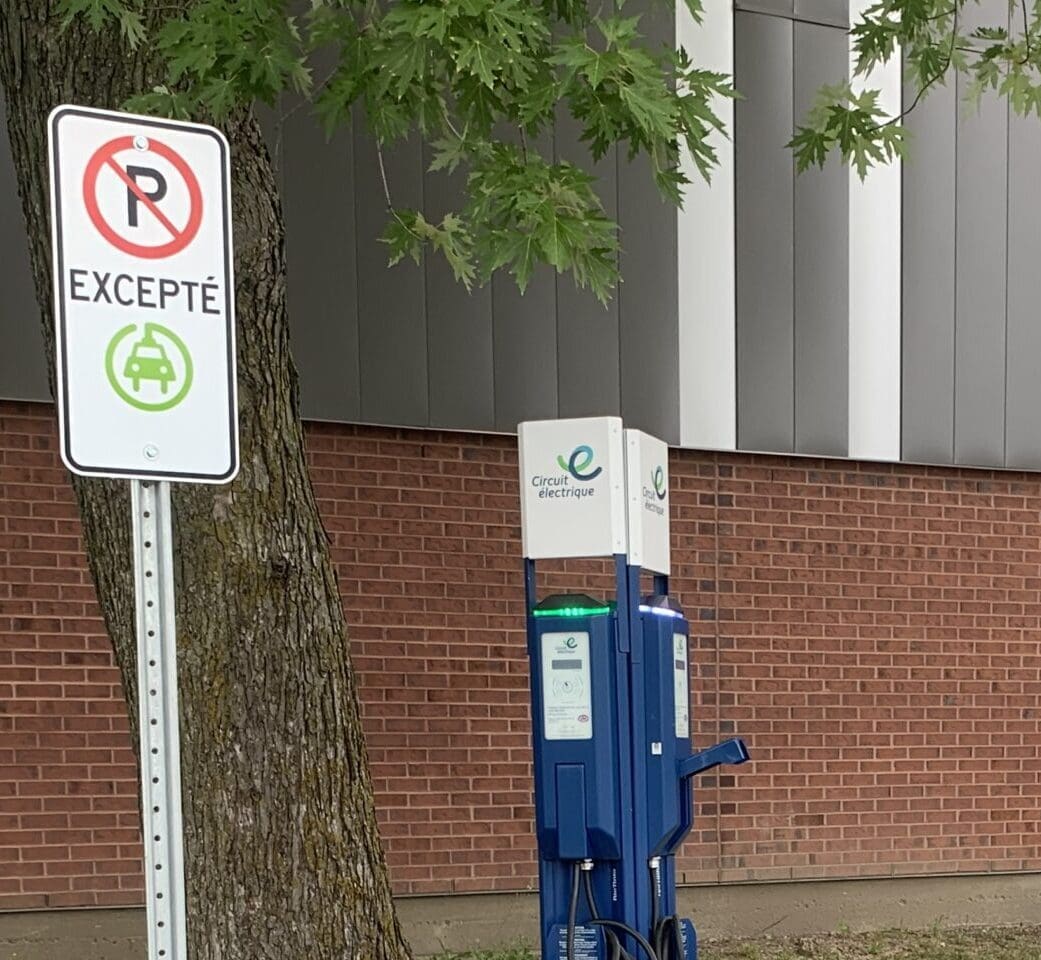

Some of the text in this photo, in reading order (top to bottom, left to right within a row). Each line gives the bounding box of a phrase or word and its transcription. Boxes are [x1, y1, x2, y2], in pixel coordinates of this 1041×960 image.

[126, 164, 168, 227] P
[70, 268, 221, 315] EXCEPTÉ
[531, 474, 569, 487] Circuit
[538, 486, 595, 500] électrique
